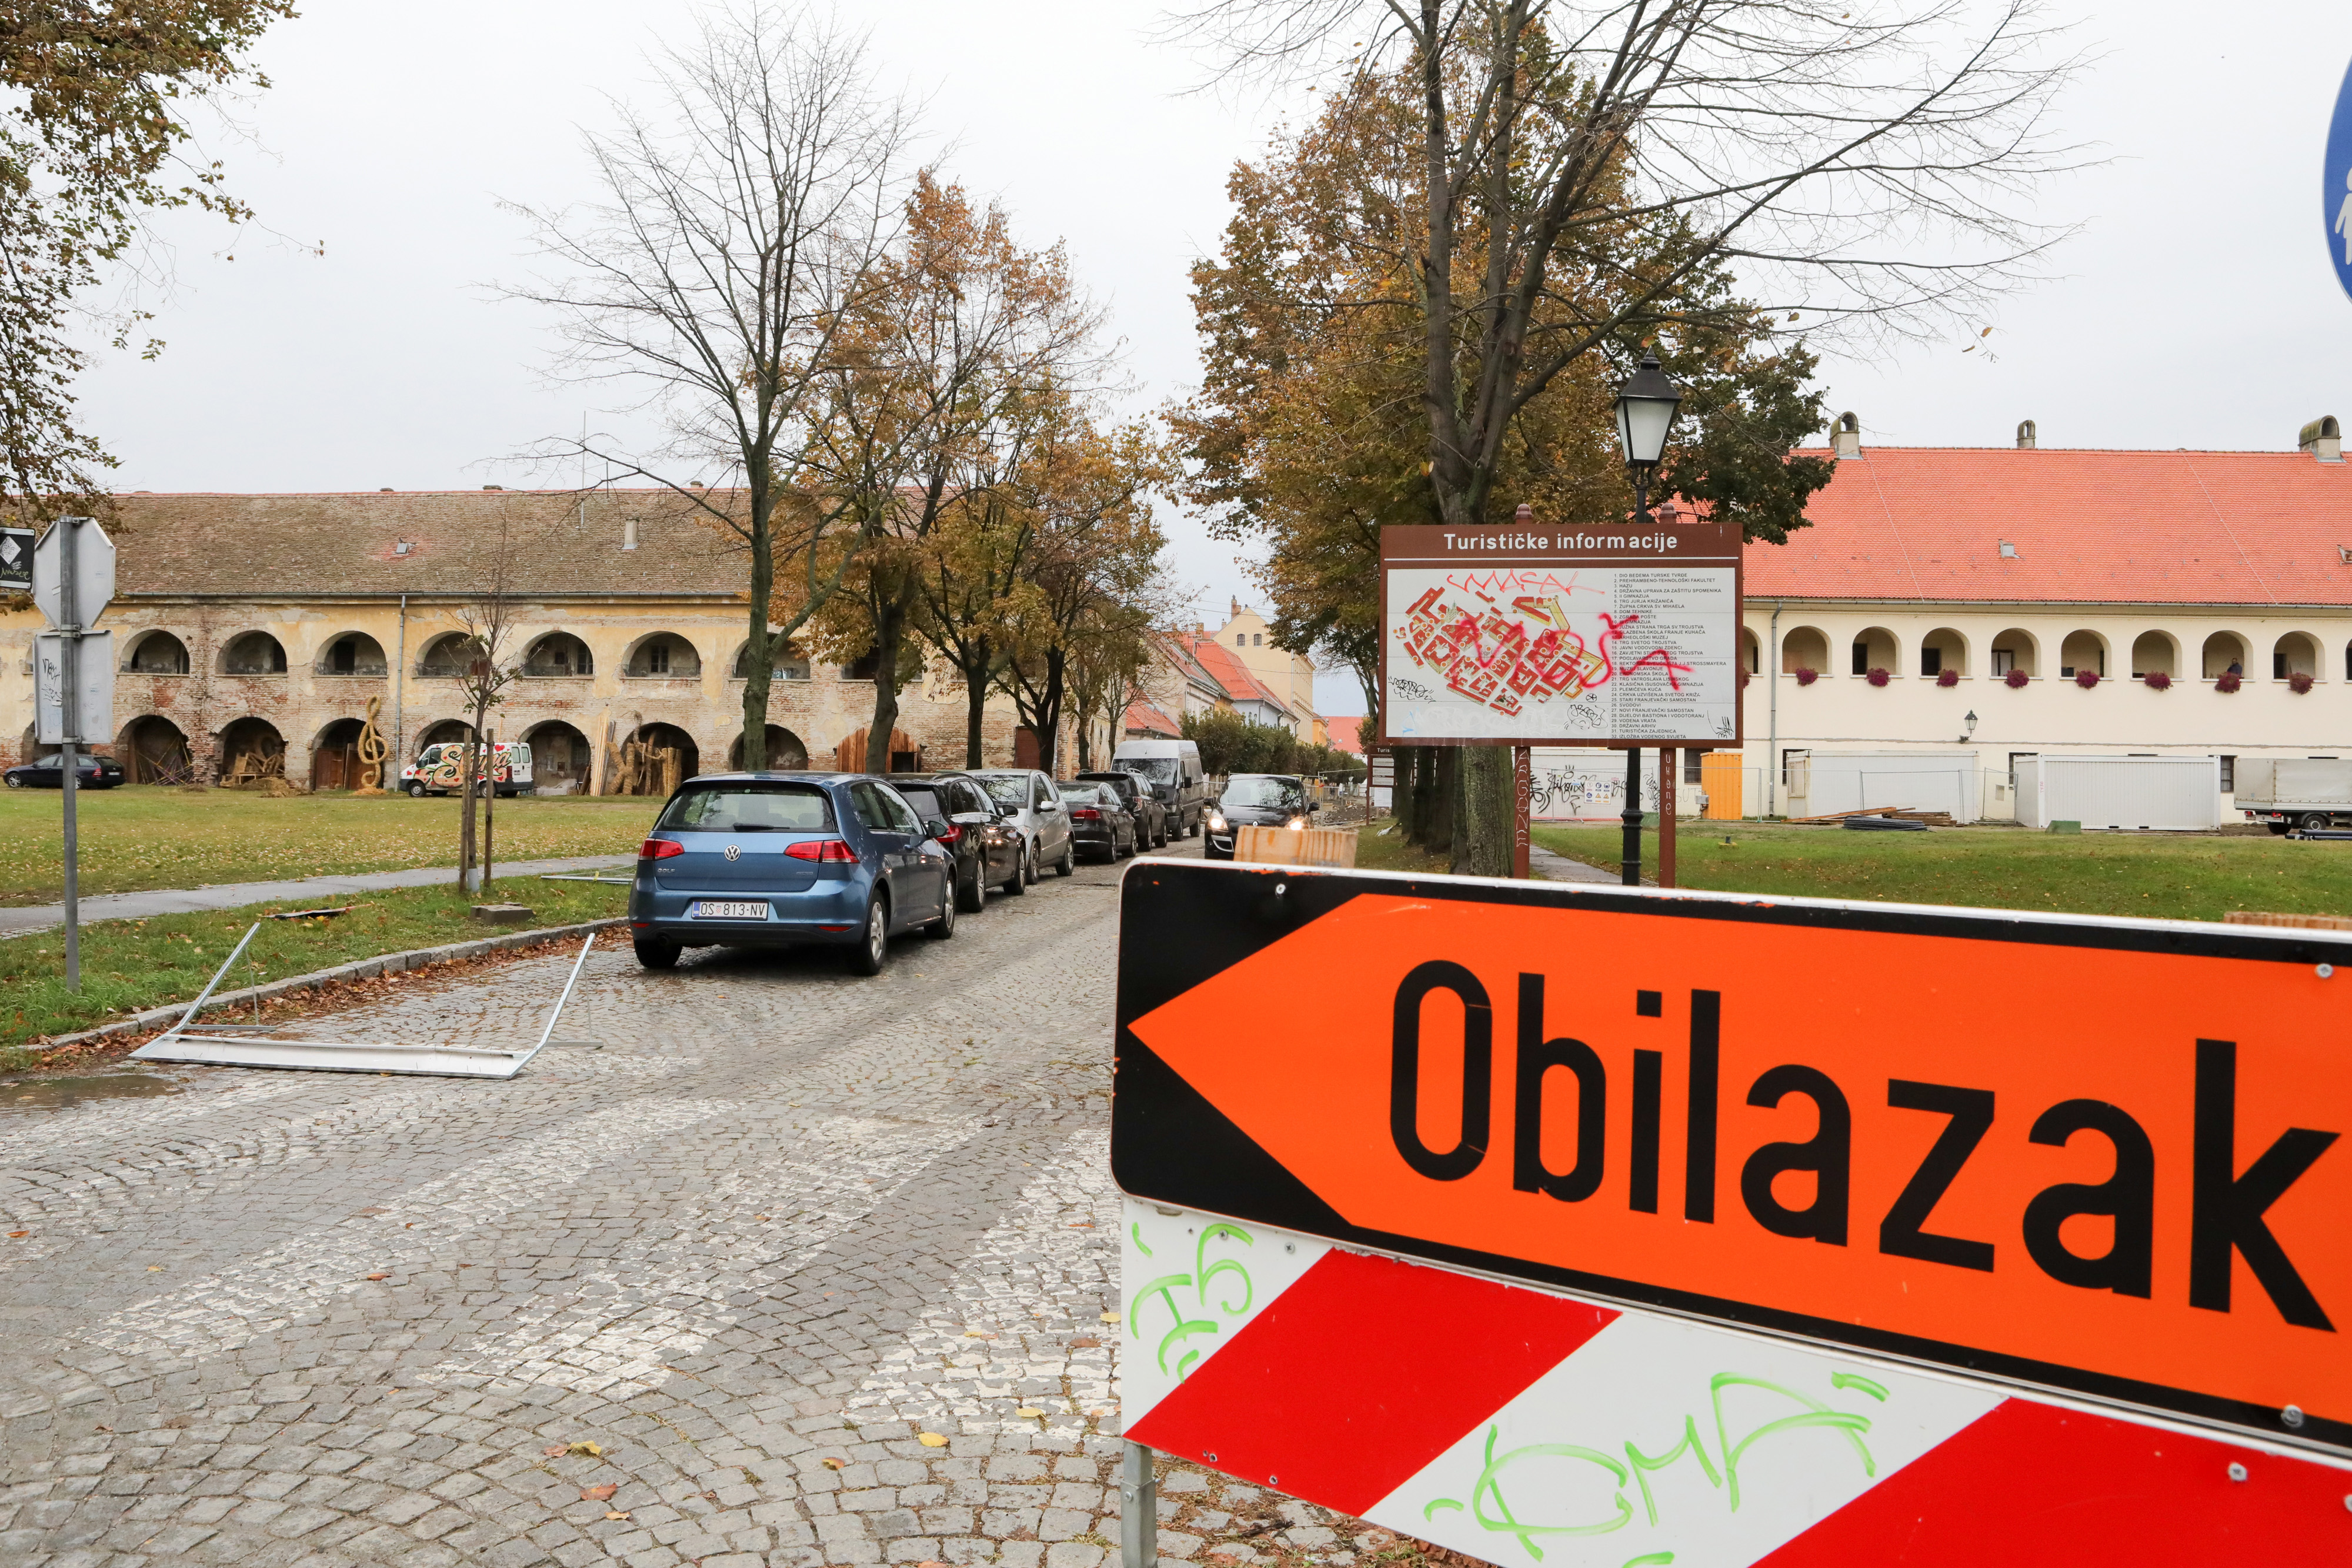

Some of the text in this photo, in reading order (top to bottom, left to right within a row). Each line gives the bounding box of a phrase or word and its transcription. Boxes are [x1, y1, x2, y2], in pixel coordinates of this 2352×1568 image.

[1444, 532, 1678, 553] Turističke informacije
[700, 903, 715, 916] OS
[1389, 958, 2341, 1334] Obilazak
